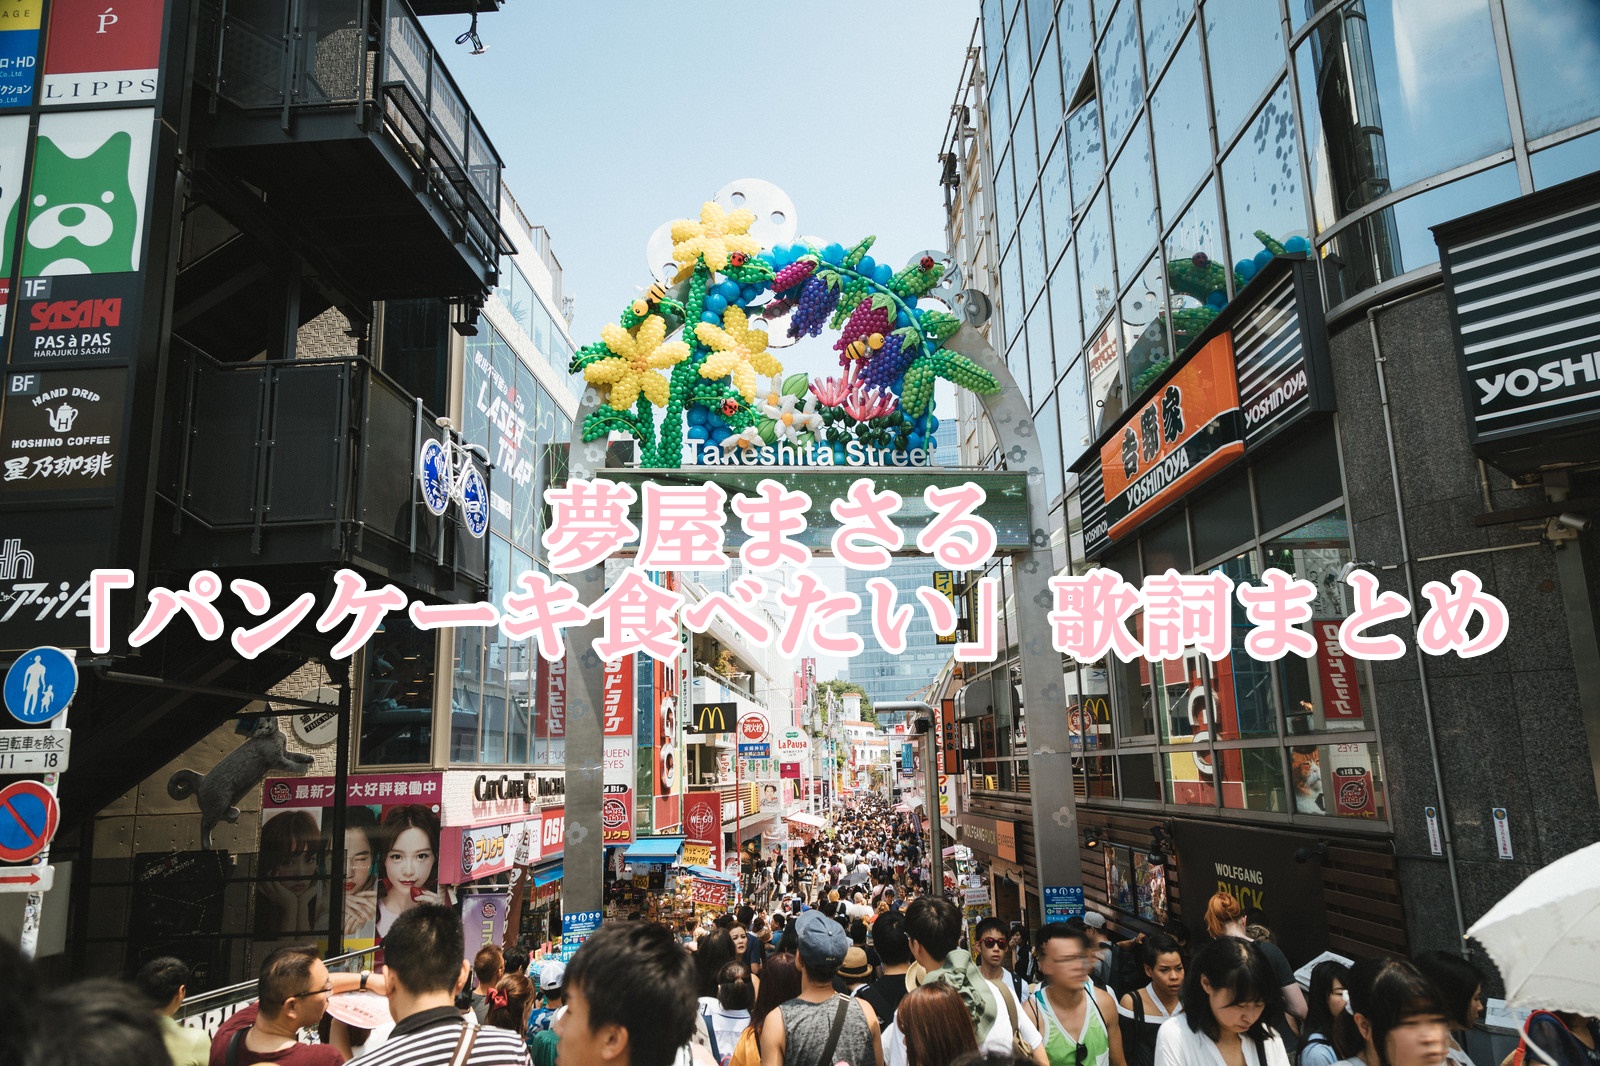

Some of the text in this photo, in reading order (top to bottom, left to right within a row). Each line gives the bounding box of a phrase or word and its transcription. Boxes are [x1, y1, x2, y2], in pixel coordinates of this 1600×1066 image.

[0, 84, 32, 96] クション
[46, 78, 156, 99] LIPPS
[25, 279, 47, 298] 1F
[30, 298, 122, 331] SASAKI
[35, 335, 65, 350] PAS
[81, 332, 111, 347] PAS
[34, 346, 110, 358] HARAJUKU SASAKI
[11, 374, 35, 393] BF
[32, 387, 101, 407] HAND DRIP
[1244, 368, 1308, 430] YOSHINOYA
[477, 379, 526, 450] LASER
[11, 435, 111, 449] HOSHINO COFFEE
[1121, 384, 1185, 481] 吉野家
[495, 435, 534, 488] TRAP
[685, 438, 938, 467] Takeshita Street
[3, 451, 115, 482] 星乃珈琲
[1125, 446, 1190, 512] YOSHINOYA
[743, 723, 763, 733] 消火栓
[0, 736, 65, 751] 自転車を除く
[43, 752, 58, 768] 18
[1214, 862, 1264, 885] WOLFGANG
